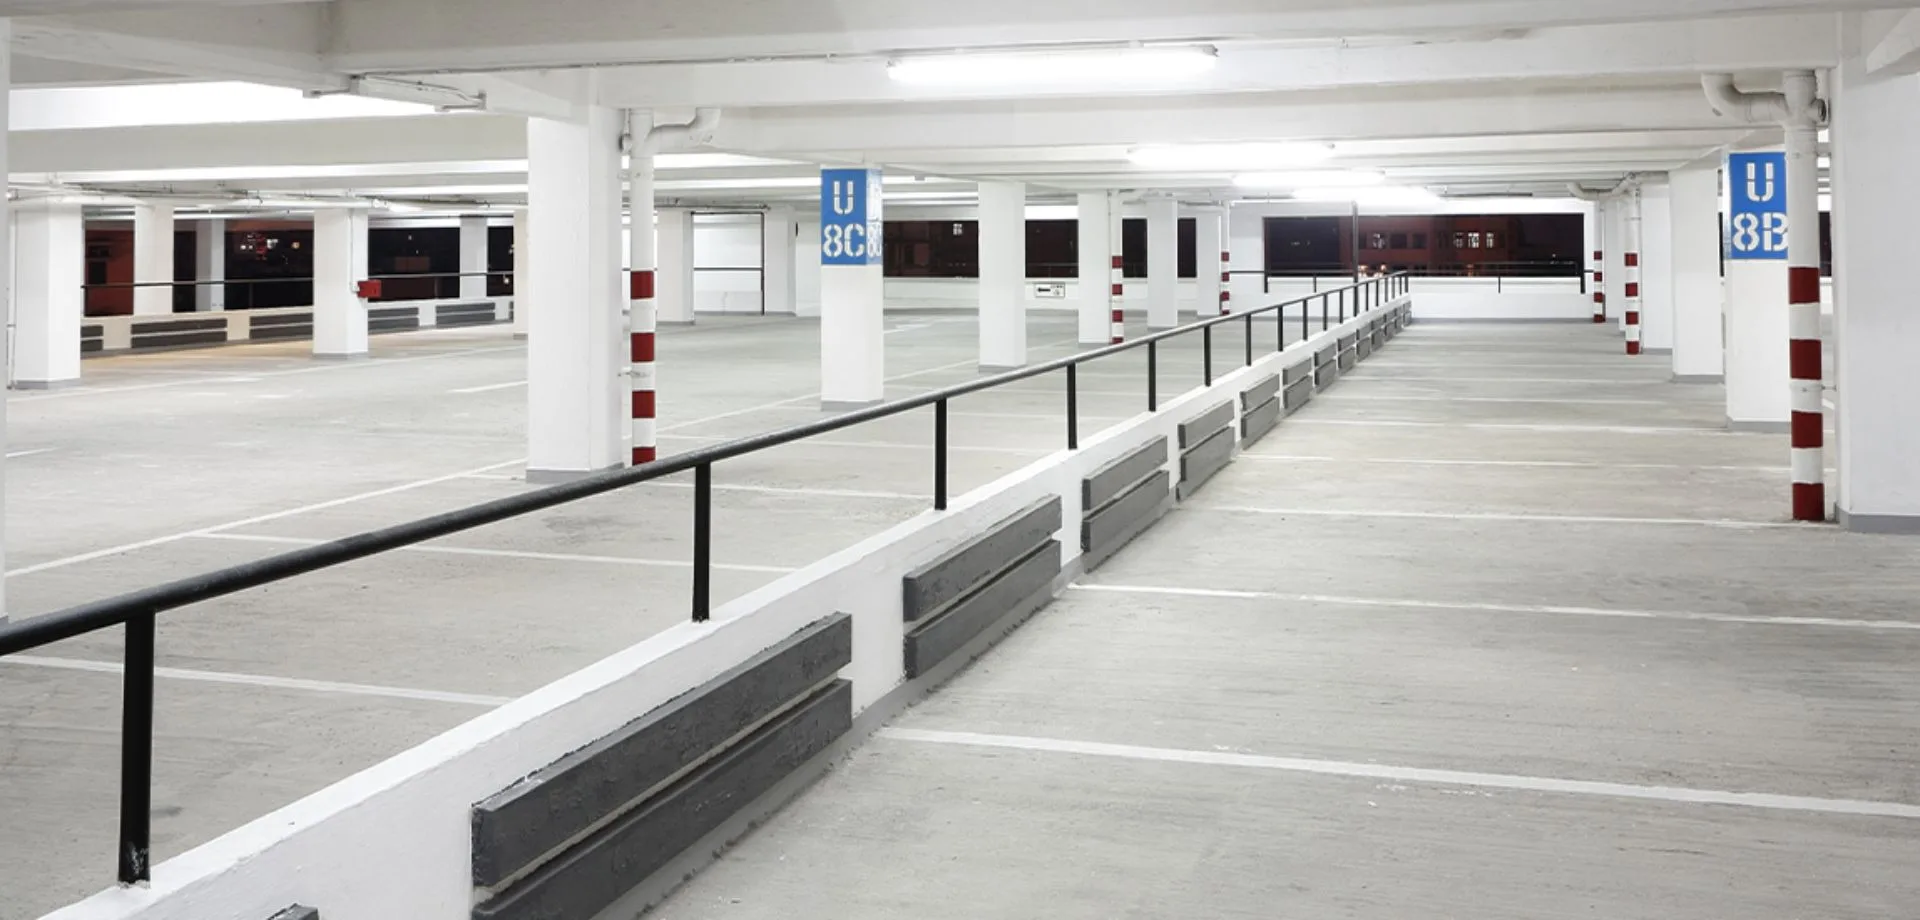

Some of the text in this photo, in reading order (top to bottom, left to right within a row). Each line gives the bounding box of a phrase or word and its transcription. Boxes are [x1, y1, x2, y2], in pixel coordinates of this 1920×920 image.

[834, 181, 854, 215] U
[1747, 163, 1774, 202] U
[823, 224, 865, 257] 8C
[1733, 212, 1788, 251] 8B
